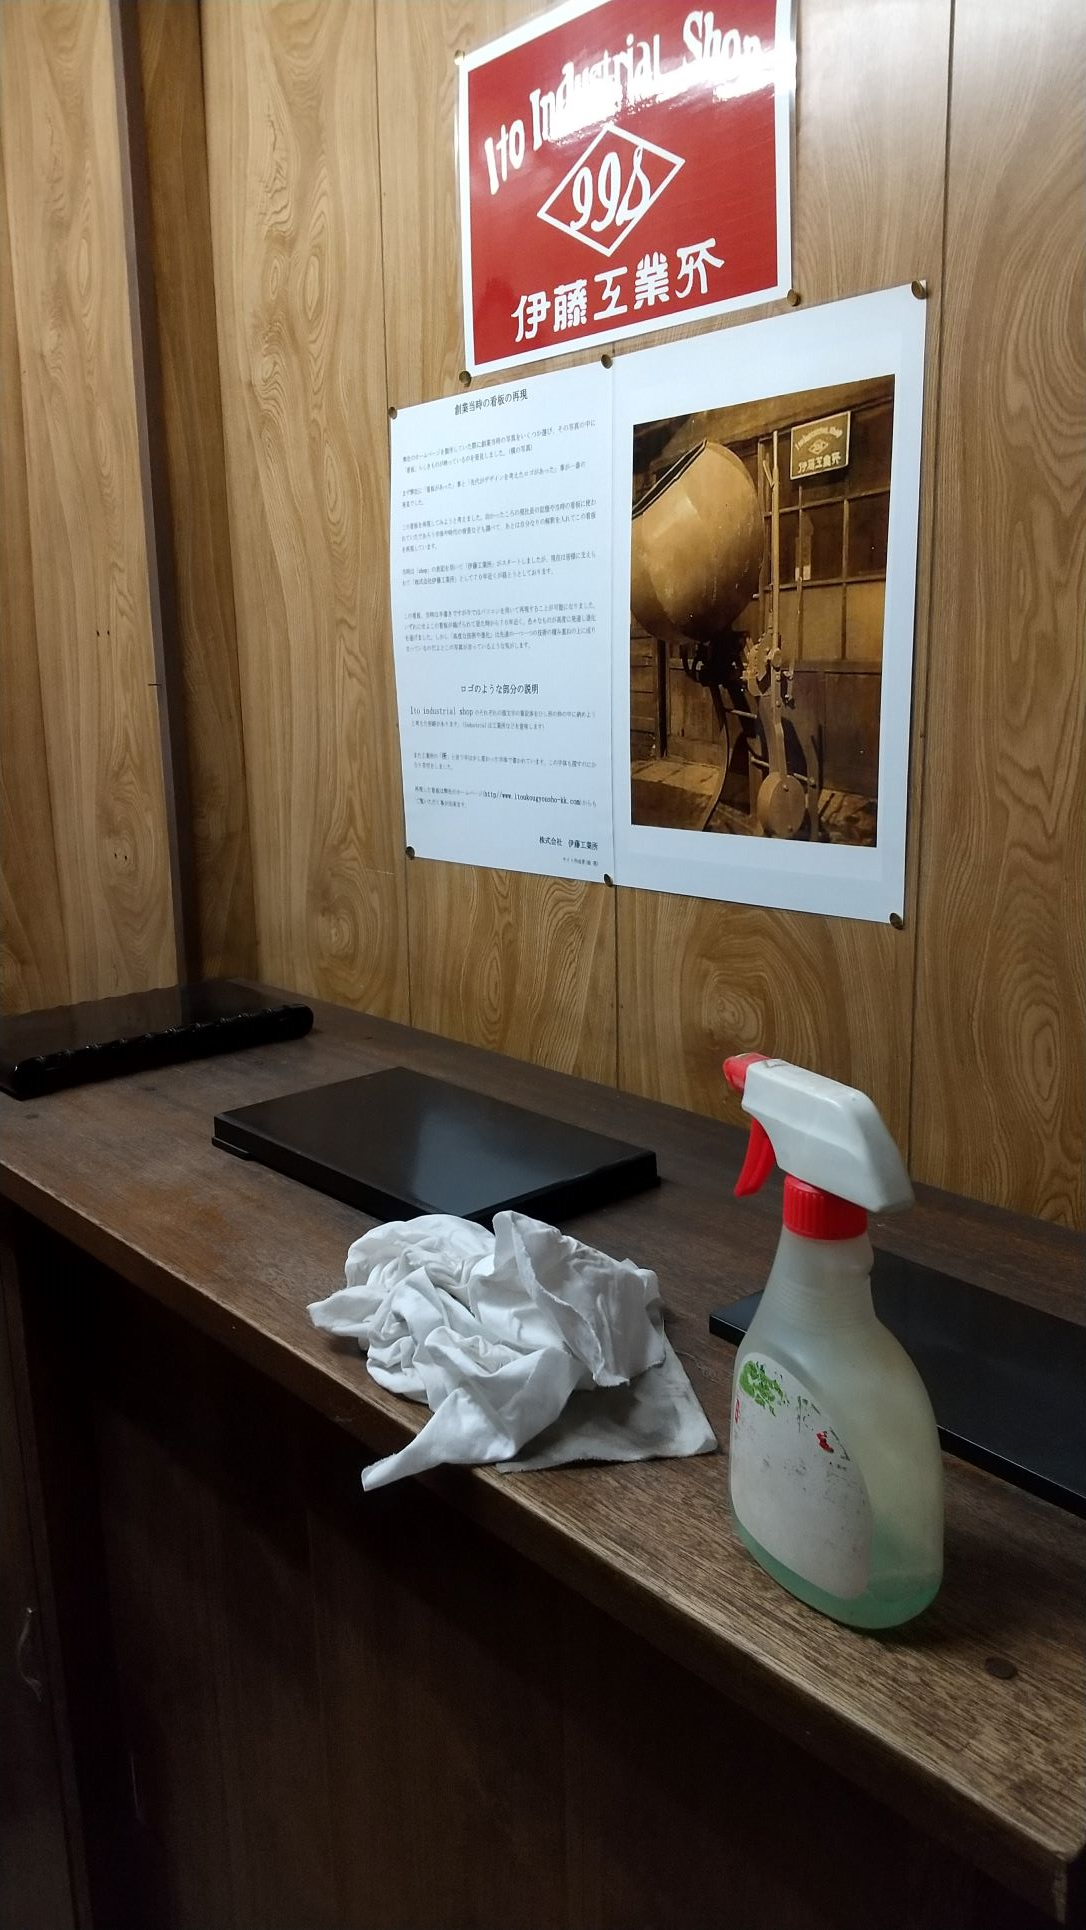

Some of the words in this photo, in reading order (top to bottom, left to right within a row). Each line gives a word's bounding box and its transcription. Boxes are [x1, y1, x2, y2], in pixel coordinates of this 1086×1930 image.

[484, 119, 525, 195] Ito
[529, 33, 661, 151] Industrial
[511, 238, 725, 342] 伊藤工業所
[453, 386, 528, 416] 創業当時の看板の再現
[460, 683, 539, 695] ロゴのような部分の説明
[410, 705, 420, 714] Ito
[422, 705, 455, 715] industrial
[459, 706, 473, 717] shop
[539, 834, 562, 847] 株式会社
[567, 838, 598, 851] 伊藤工業所
